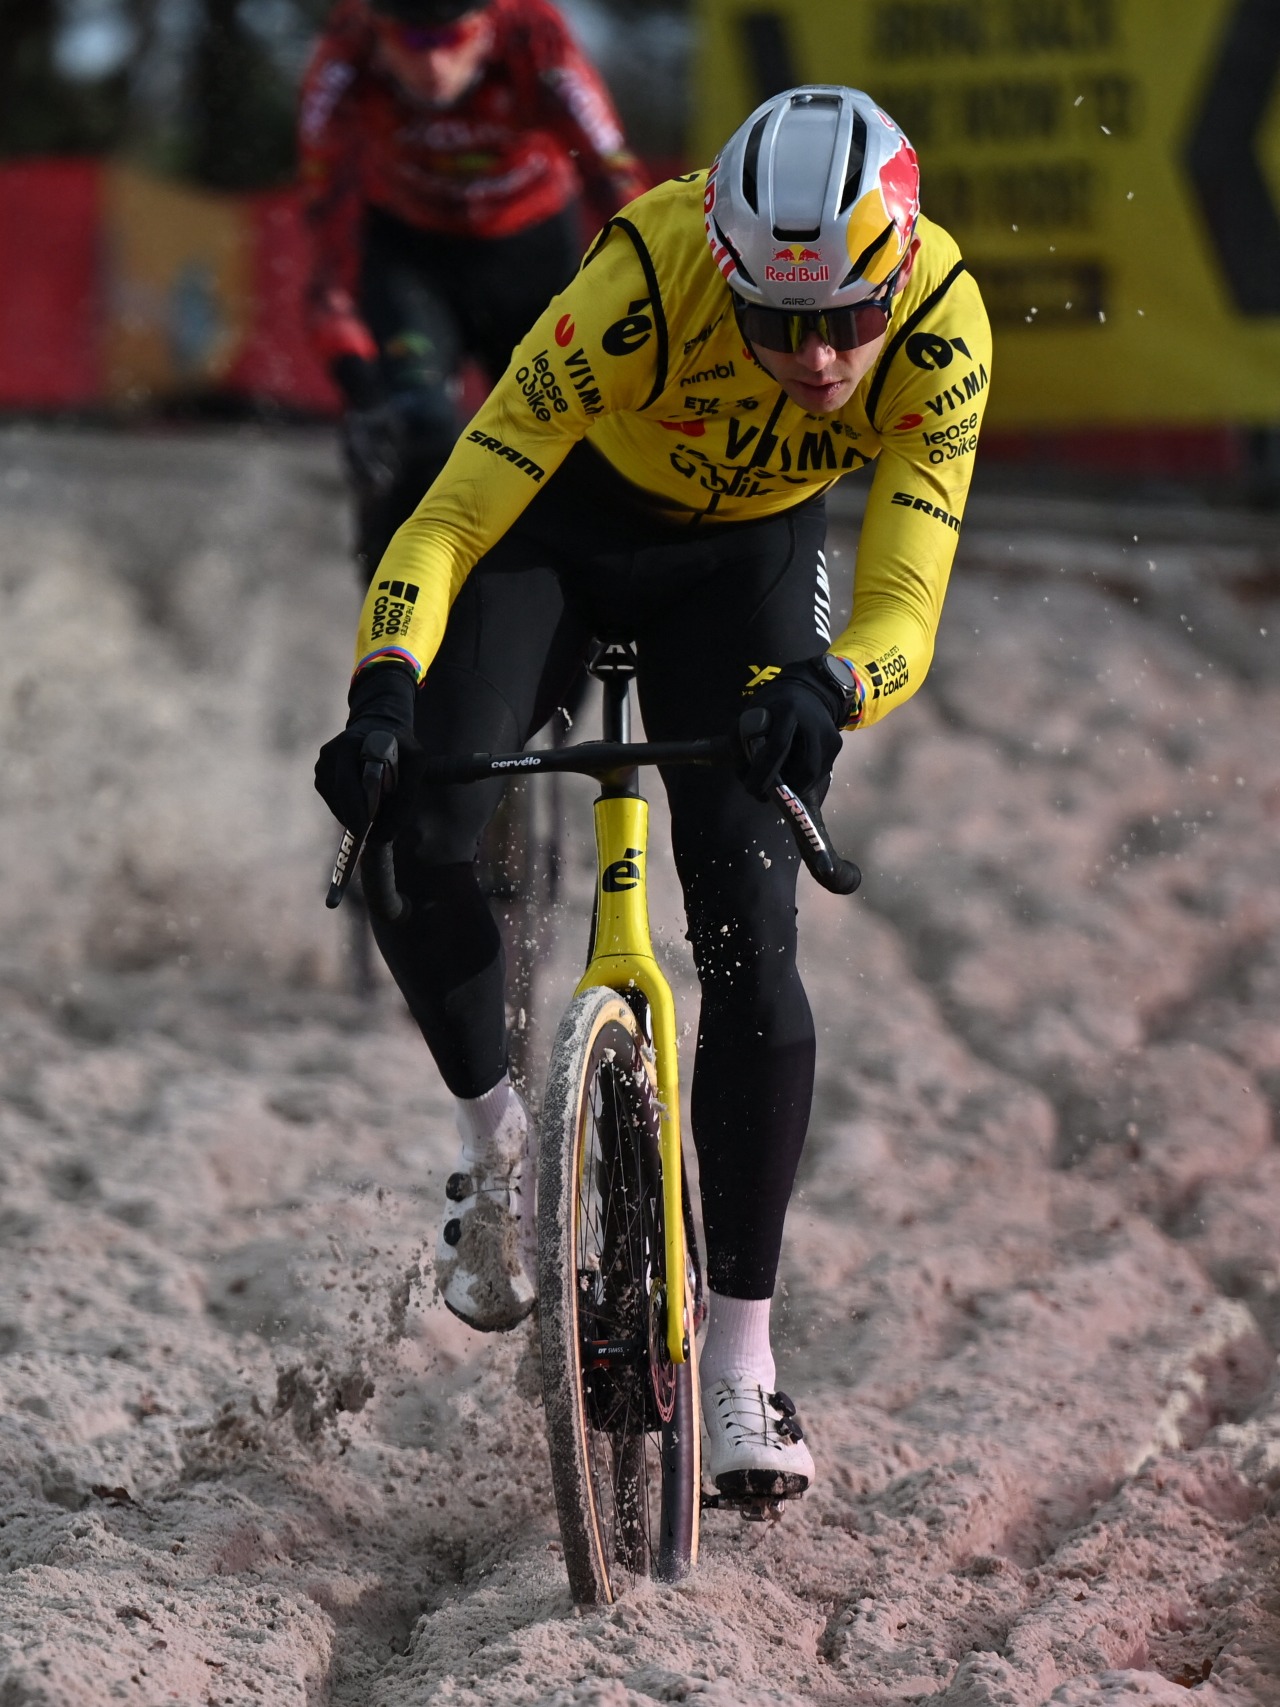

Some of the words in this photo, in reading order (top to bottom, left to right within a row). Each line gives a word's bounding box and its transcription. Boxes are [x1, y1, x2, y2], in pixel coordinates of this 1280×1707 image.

[766, 264, 796, 282] Red
[798, 263, 829, 282] Bull
[781, 297, 816, 306] GIRO
[532, 349, 569, 414] lease
[564, 348, 605, 416] VISMA
[680, 361, 735, 388] nimbl
[925, 363, 988, 416] VISMA
[922, 412, 978, 446] lease
[466, 430, 546, 483] SRAM
[891, 491, 961, 534] SRAM
[371, 595, 389, 641] COACH
[385, 602, 405, 635] FOOD
[882, 654, 907, 680] FOOD
[883, 669, 909, 697] COACH
[491, 756, 542, 769] cervélo
[332, 828, 355, 887] SRA
